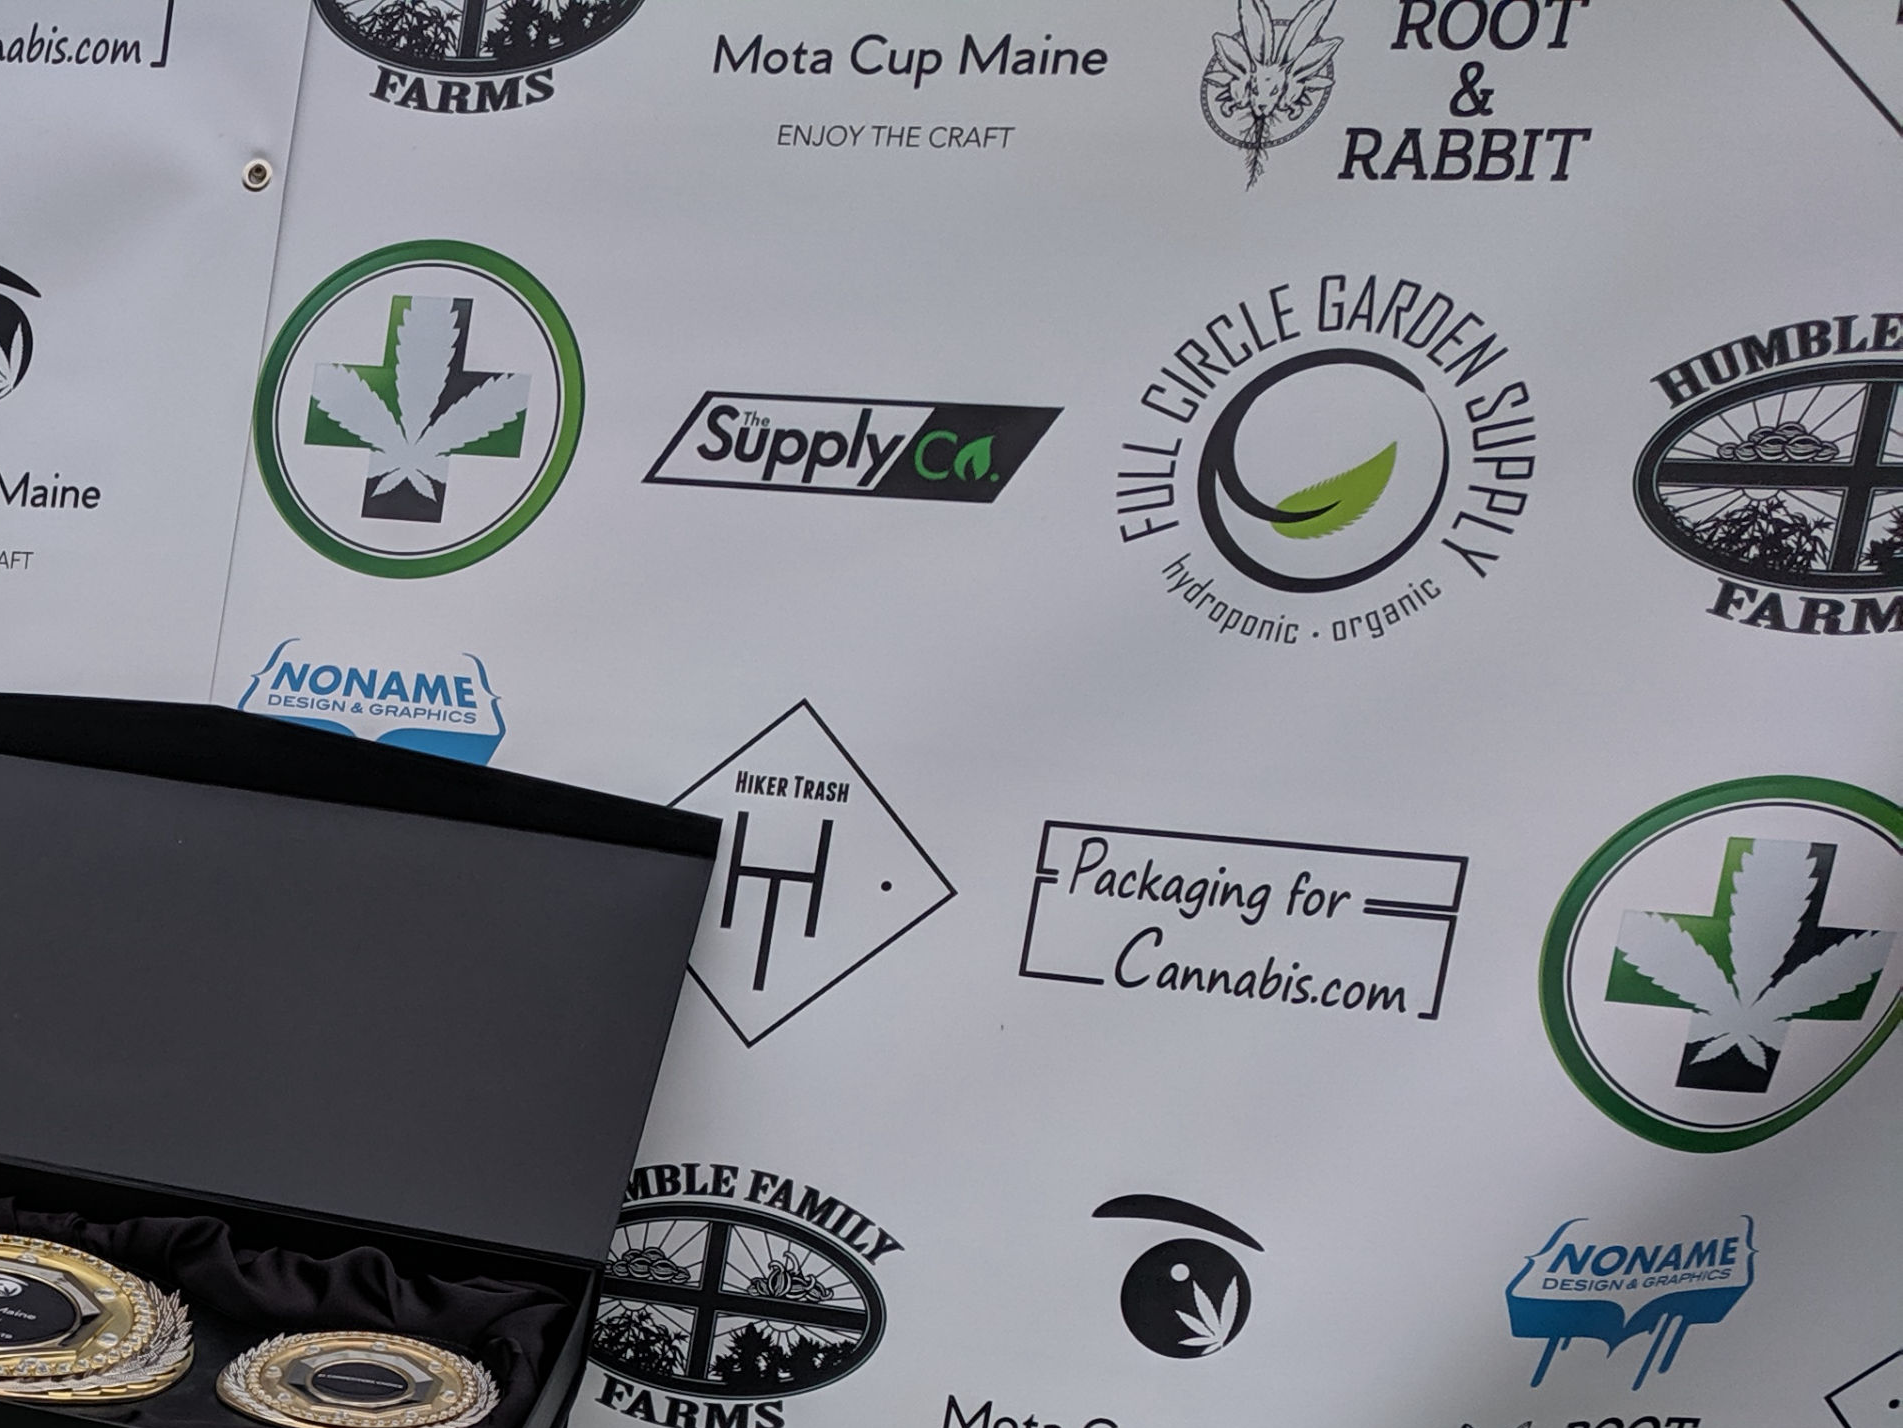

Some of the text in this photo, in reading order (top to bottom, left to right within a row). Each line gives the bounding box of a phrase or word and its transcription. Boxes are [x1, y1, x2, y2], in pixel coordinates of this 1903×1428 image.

[1390, 0, 1591, 50] ROOT
[713, 32, 1108, 90] Mota Cup Maine
[1449, 61, 1494, 117] &
[369, 65, 555, 114] FARMS
[777, 124, 1016, 149] ENJOY THE CRAFT
[1337, 127, 1592, 181] RABBIT
[1650, 313, 1903, 409] HUMBLE
[696, 404, 905, 487] Supply
[743, 411, 770, 428] The
[1115, 274, 1537, 579] FULL CIRCLE GARDEN SUPPLY
[1162, 553, 1442, 644] hydroponic organic
[1706, 577, 1903, 635] FARM
[268, 694, 477, 724] DESIGN & GRAPHICS
[270, 661, 478, 709] NONAME
[1069, 836, 1351, 924] Packaging for
[1114, 926, 1407, 1013] Cannabis.com
[623, 1163, 905, 1266] MBLE FAMILY
[1542, 1268, 1732, 1291] DESIGN & GRAPHICS
[1547, 1236, 1740, 1276] NONAME
